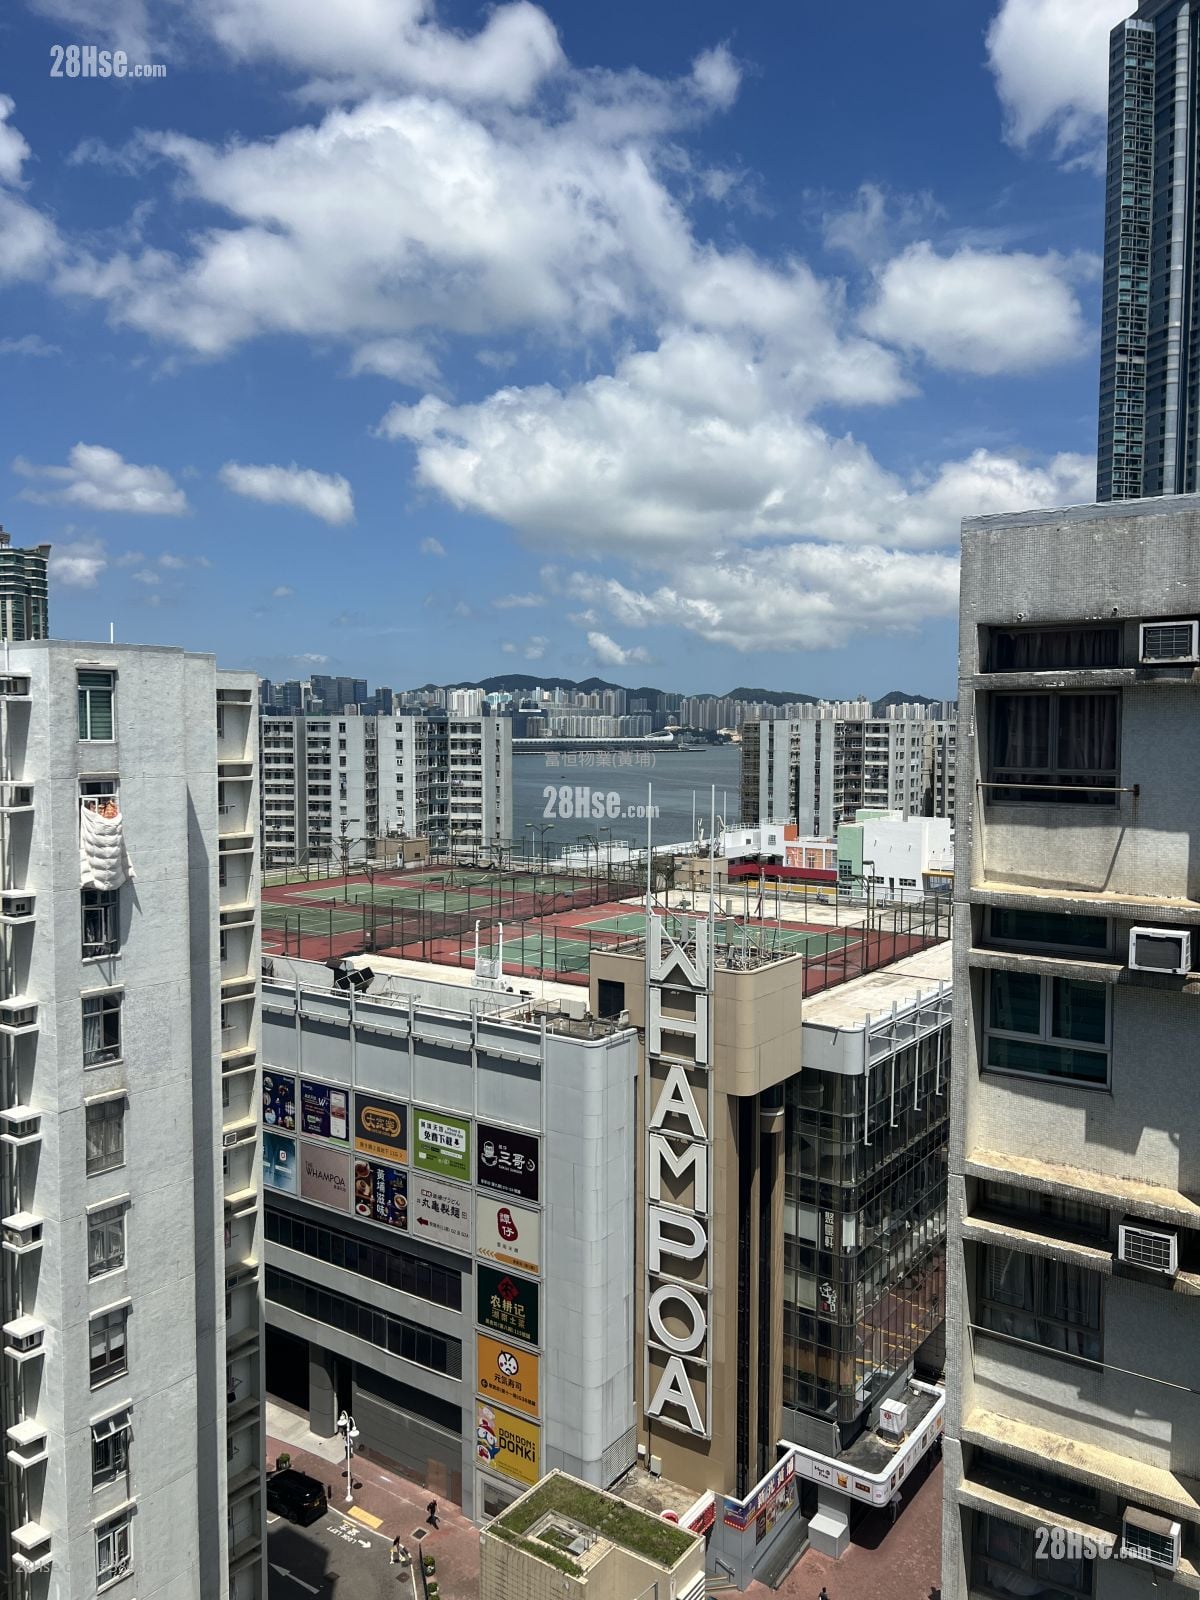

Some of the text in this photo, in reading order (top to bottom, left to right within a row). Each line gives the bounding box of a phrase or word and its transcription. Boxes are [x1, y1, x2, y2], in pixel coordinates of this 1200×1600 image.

[499, 1151, 525, 1169] 三哥
[306, 1166, 345, 1187] WHAMPOA
[649, 915, 708, 1436] WHAMPOA
[490, 1295, 525, 1318] 农耕记
[499, 1428, 514, 1441] DON
